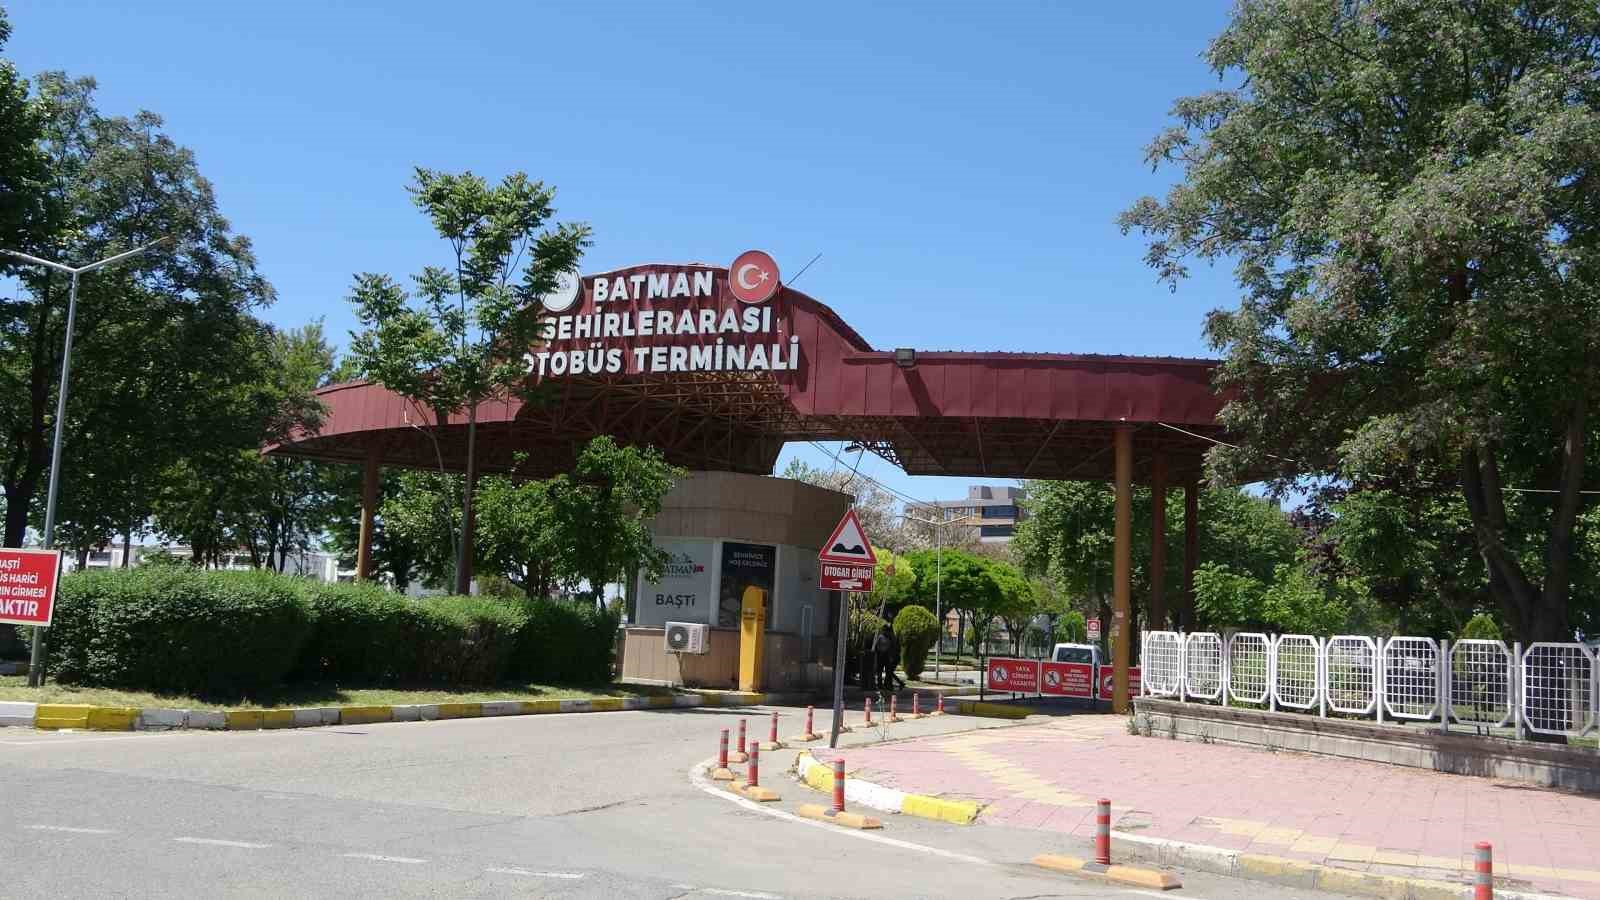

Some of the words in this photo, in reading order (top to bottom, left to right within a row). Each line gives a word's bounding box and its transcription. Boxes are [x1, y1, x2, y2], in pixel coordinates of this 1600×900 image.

[593, 271, 714, 302] BATMAN
[542, 306, 772, 348] ŞEHİRLERARASI
[634, 336, 799, 373] TERMİNALİ
[0, 557, 20, 571] AŞTİ
[661, 563, 697, 575] ATMAN
[9, 571, 38, 584] HARİCİ
[824, 566, 850, 577] OTOGAR
[12, 584, 47, 598] GİRMESİ
[656, 594, 696, 609] BAŞTİ
